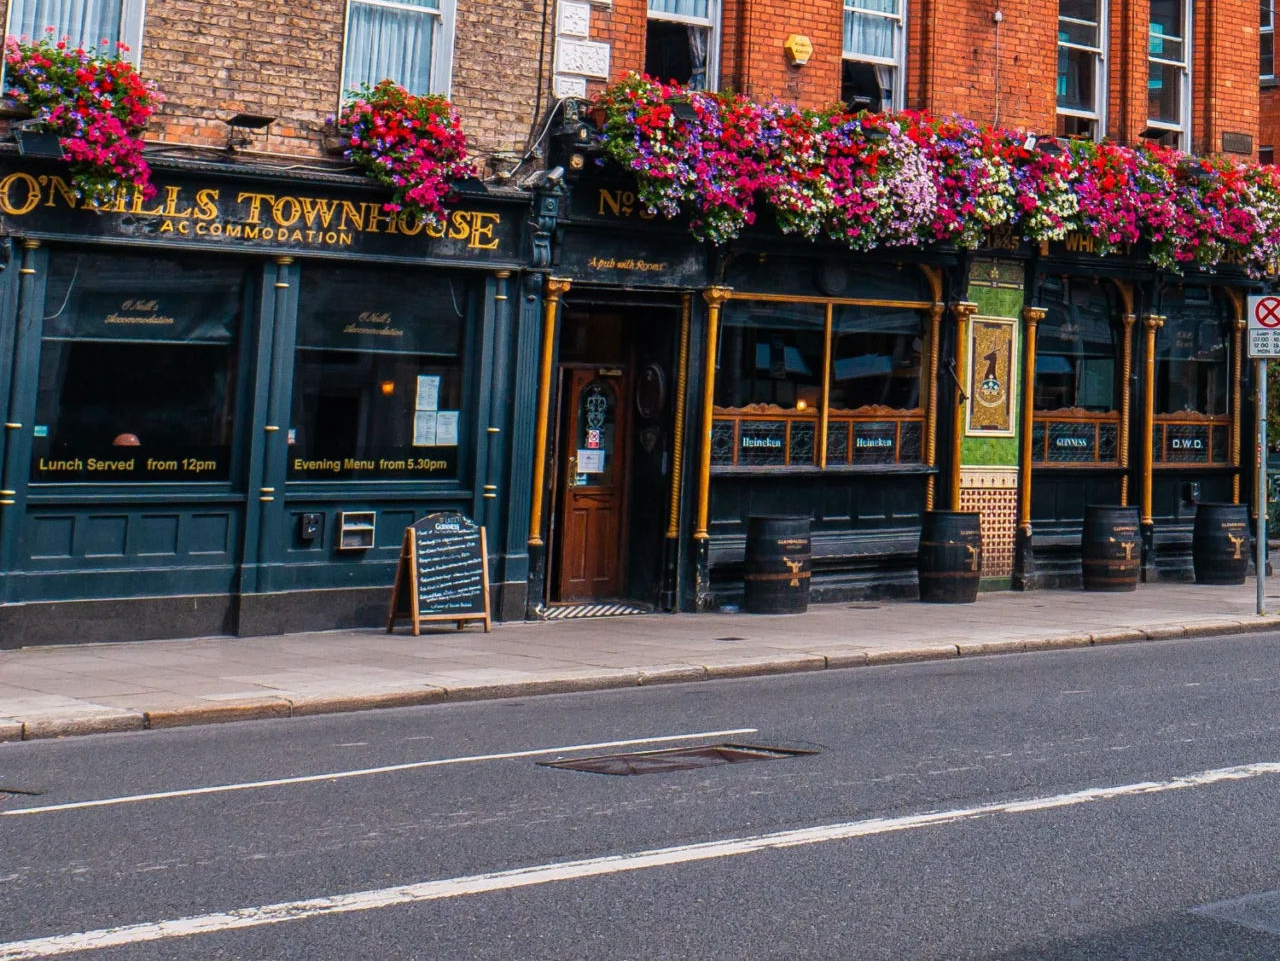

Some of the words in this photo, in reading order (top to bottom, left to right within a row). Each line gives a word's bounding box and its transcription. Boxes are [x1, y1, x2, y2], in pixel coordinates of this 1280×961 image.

[0, 172, 219, 220] O'NILLS
[160, 220, 352, 246] ACCOMMODATION
[597, 257, 616, 270] pub
[616, 259, 635, 270] with
[104, 312, 174, 324] Accommodation
[742, 437, 781, 448] Heineken
[856, 437, 892, 448] Heineken
[1056, 438, 1087, 447] GUINNESS
[1172, 439, 1203, 449] D.W.D.
[39, 458, 83, 470] Lunch
[87, 458, 135, 471] Served
[147, 458, 178, 470] from
[181, 458, 217, 473] 12pm
[294, 459, 341, 471] Evening
[344, 459, 374, 469] Menu
[379, 459, 405, 469] from
[407, 459, 447, 471] 5.30pm
